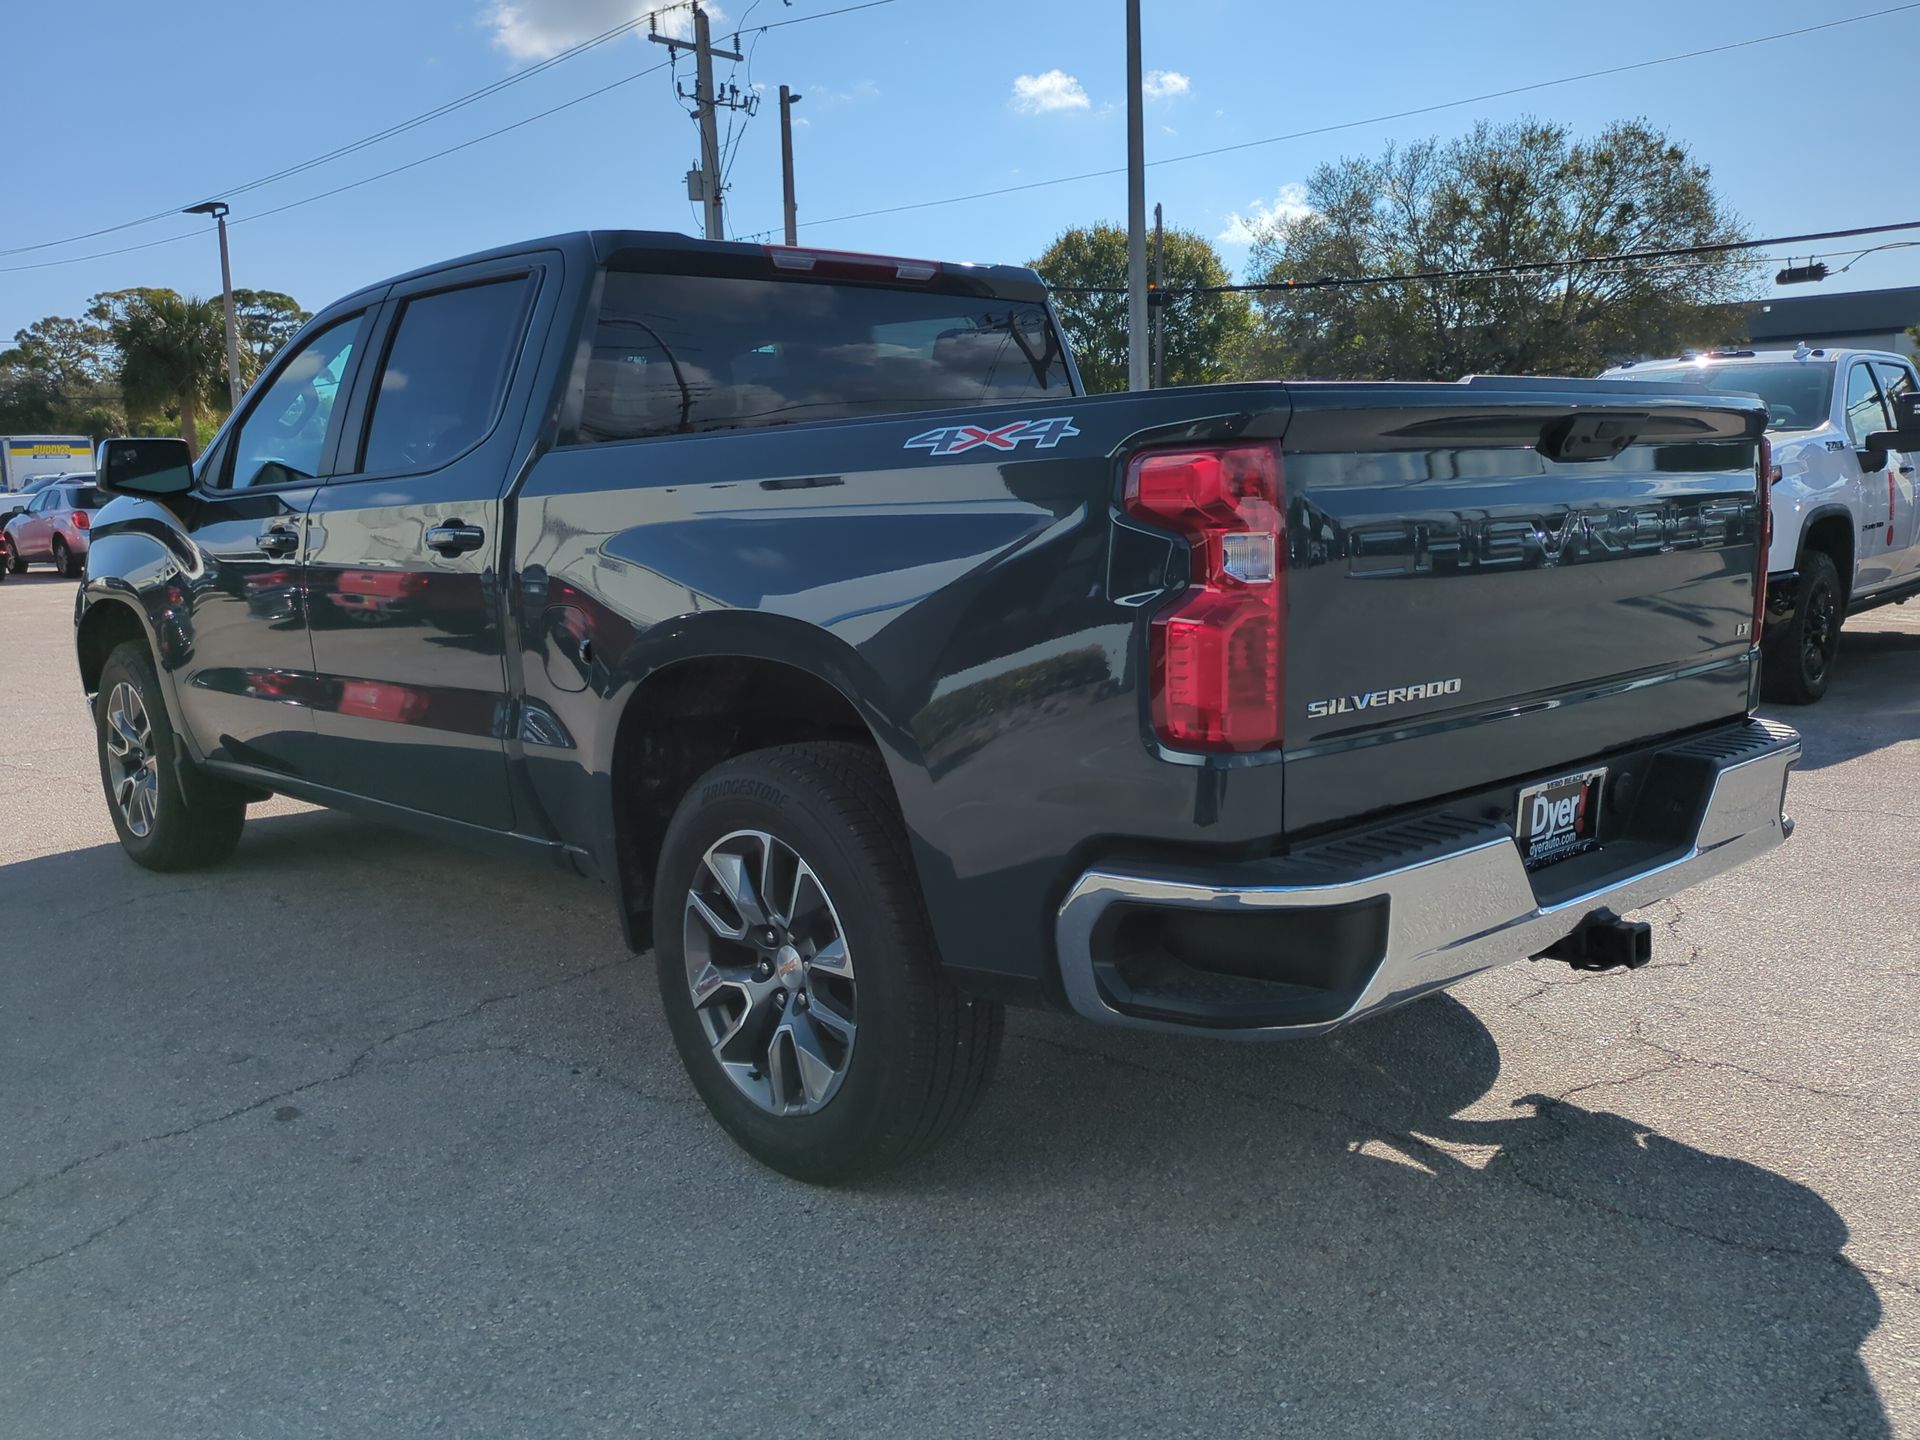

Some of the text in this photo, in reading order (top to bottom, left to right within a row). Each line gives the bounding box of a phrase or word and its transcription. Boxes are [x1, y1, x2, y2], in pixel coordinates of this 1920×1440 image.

[1307, 678, 1462, 719] SILVERADO
[702, 778, 791, 809] BRIDGESTONE
[1529, 831, 1576, 858] dyerauto.com
